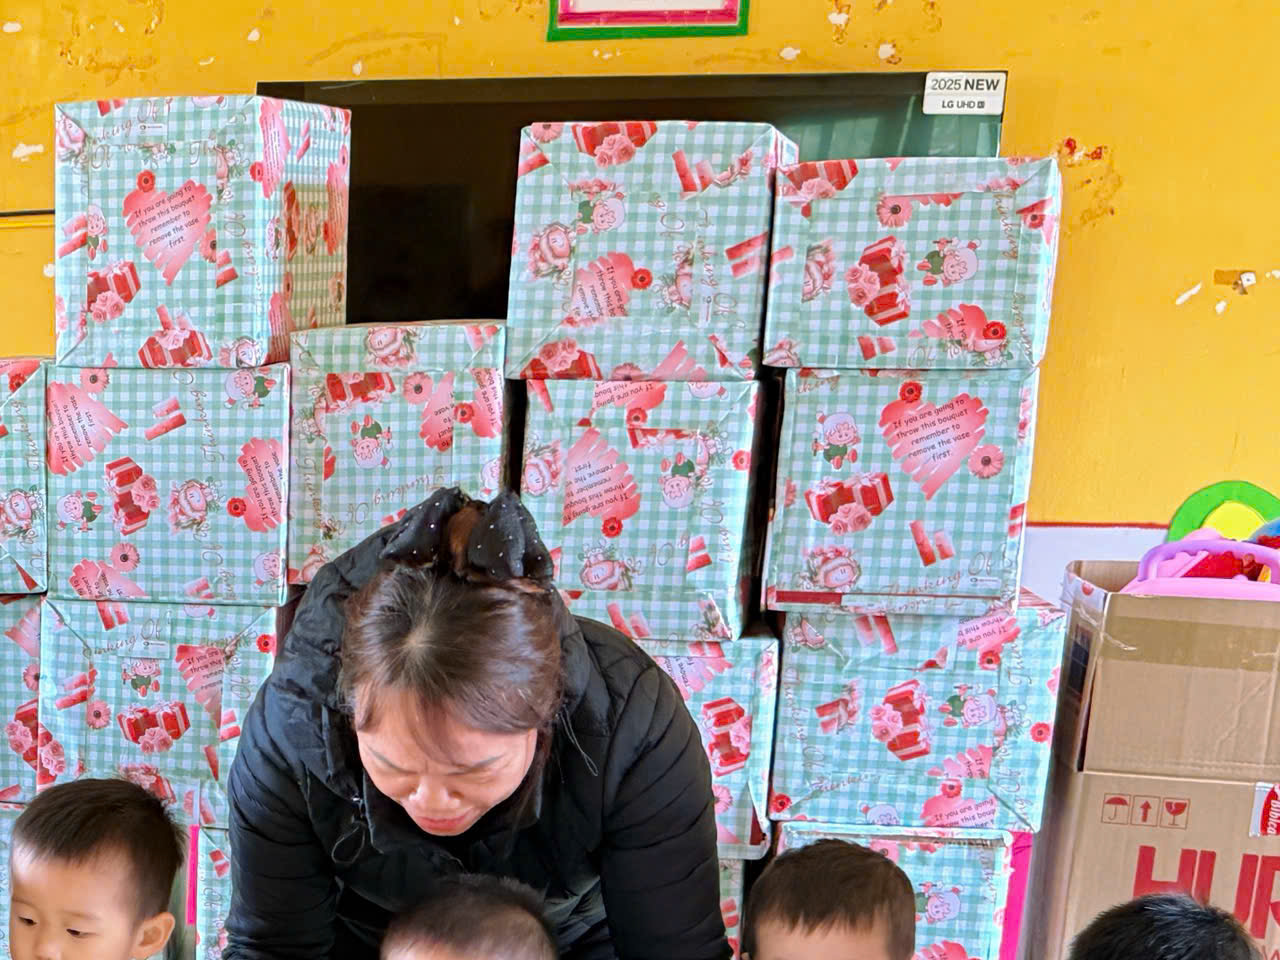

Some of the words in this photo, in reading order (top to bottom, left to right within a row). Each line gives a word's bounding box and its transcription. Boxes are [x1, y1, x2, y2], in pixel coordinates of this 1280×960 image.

[931, 79, 961, 91] 2025
[964, 79, 999, 91] NEW
[942, 100, 954, 109] LG
[956, 100, 976, 109] UHD
[893, 421, 901, 429] If
[904, 416, 918, 426] you
[920, 411, 932, 419] are
[934, 403, 954, 416] going
[896, 427, 919, 439] throw
[921, 420, 936, 430] this
[938, 409, 968, 424] bouquet
[908, 445, 936, 458] remove
[938, 438, 951, 448] the
[953, 432, 970, 442] vase
[912, 426, 950, 445] remember
